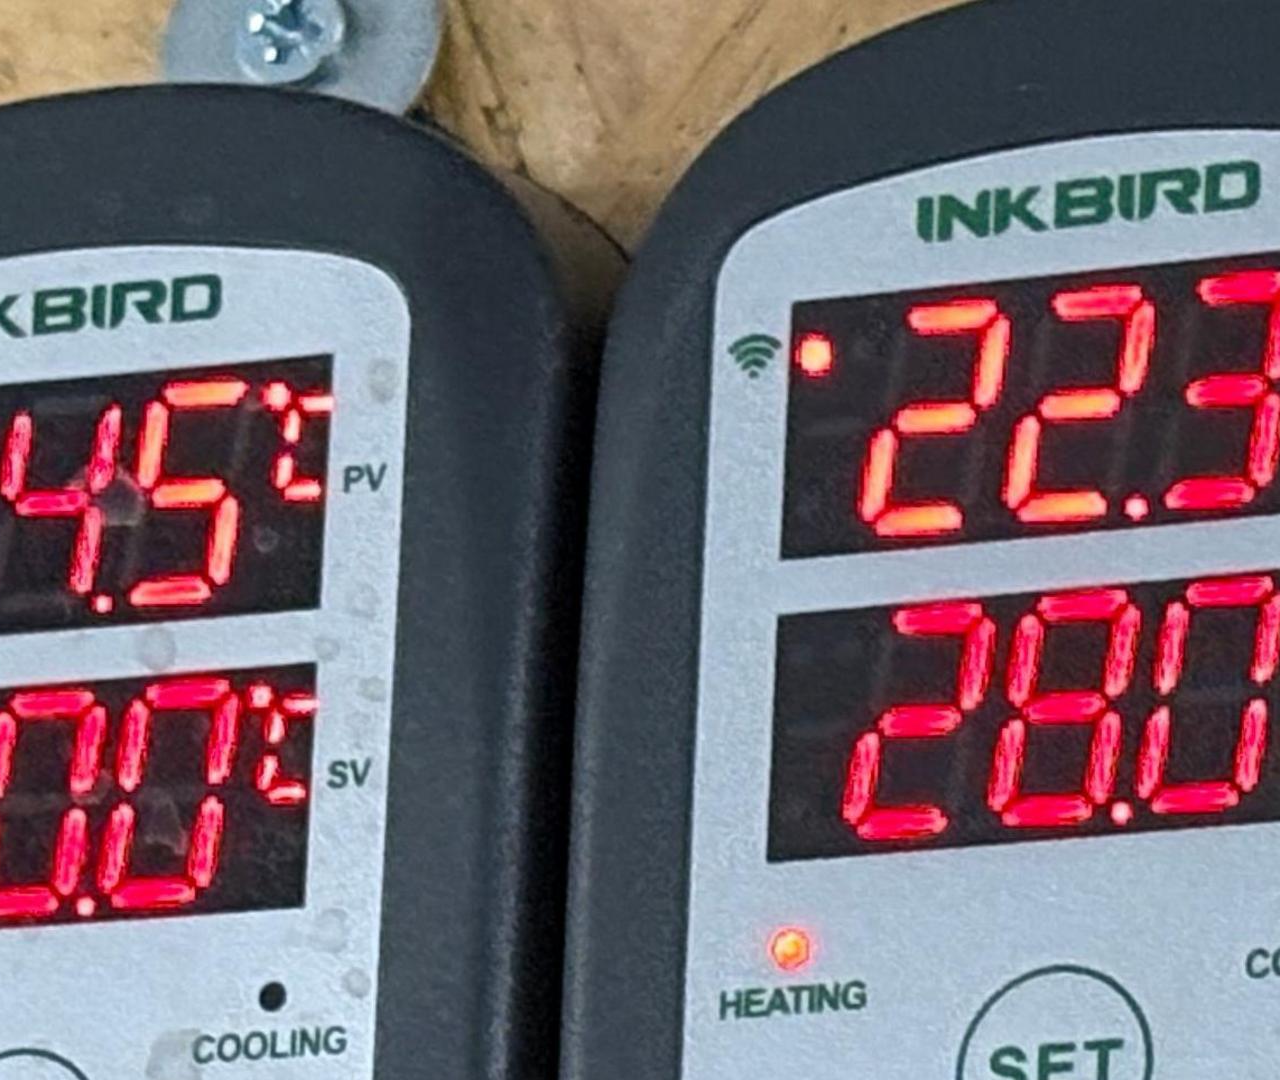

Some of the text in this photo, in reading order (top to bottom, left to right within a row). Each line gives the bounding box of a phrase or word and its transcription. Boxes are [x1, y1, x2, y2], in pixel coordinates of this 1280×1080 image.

[915, 160, 1262, 243] INKBIRD
[343, 463, 388, 494] PV
[327, 758, 372, 789] SV
[720, 980, 868, 1021] HEATING
[192, 1026, 348, 1065] COOLING
